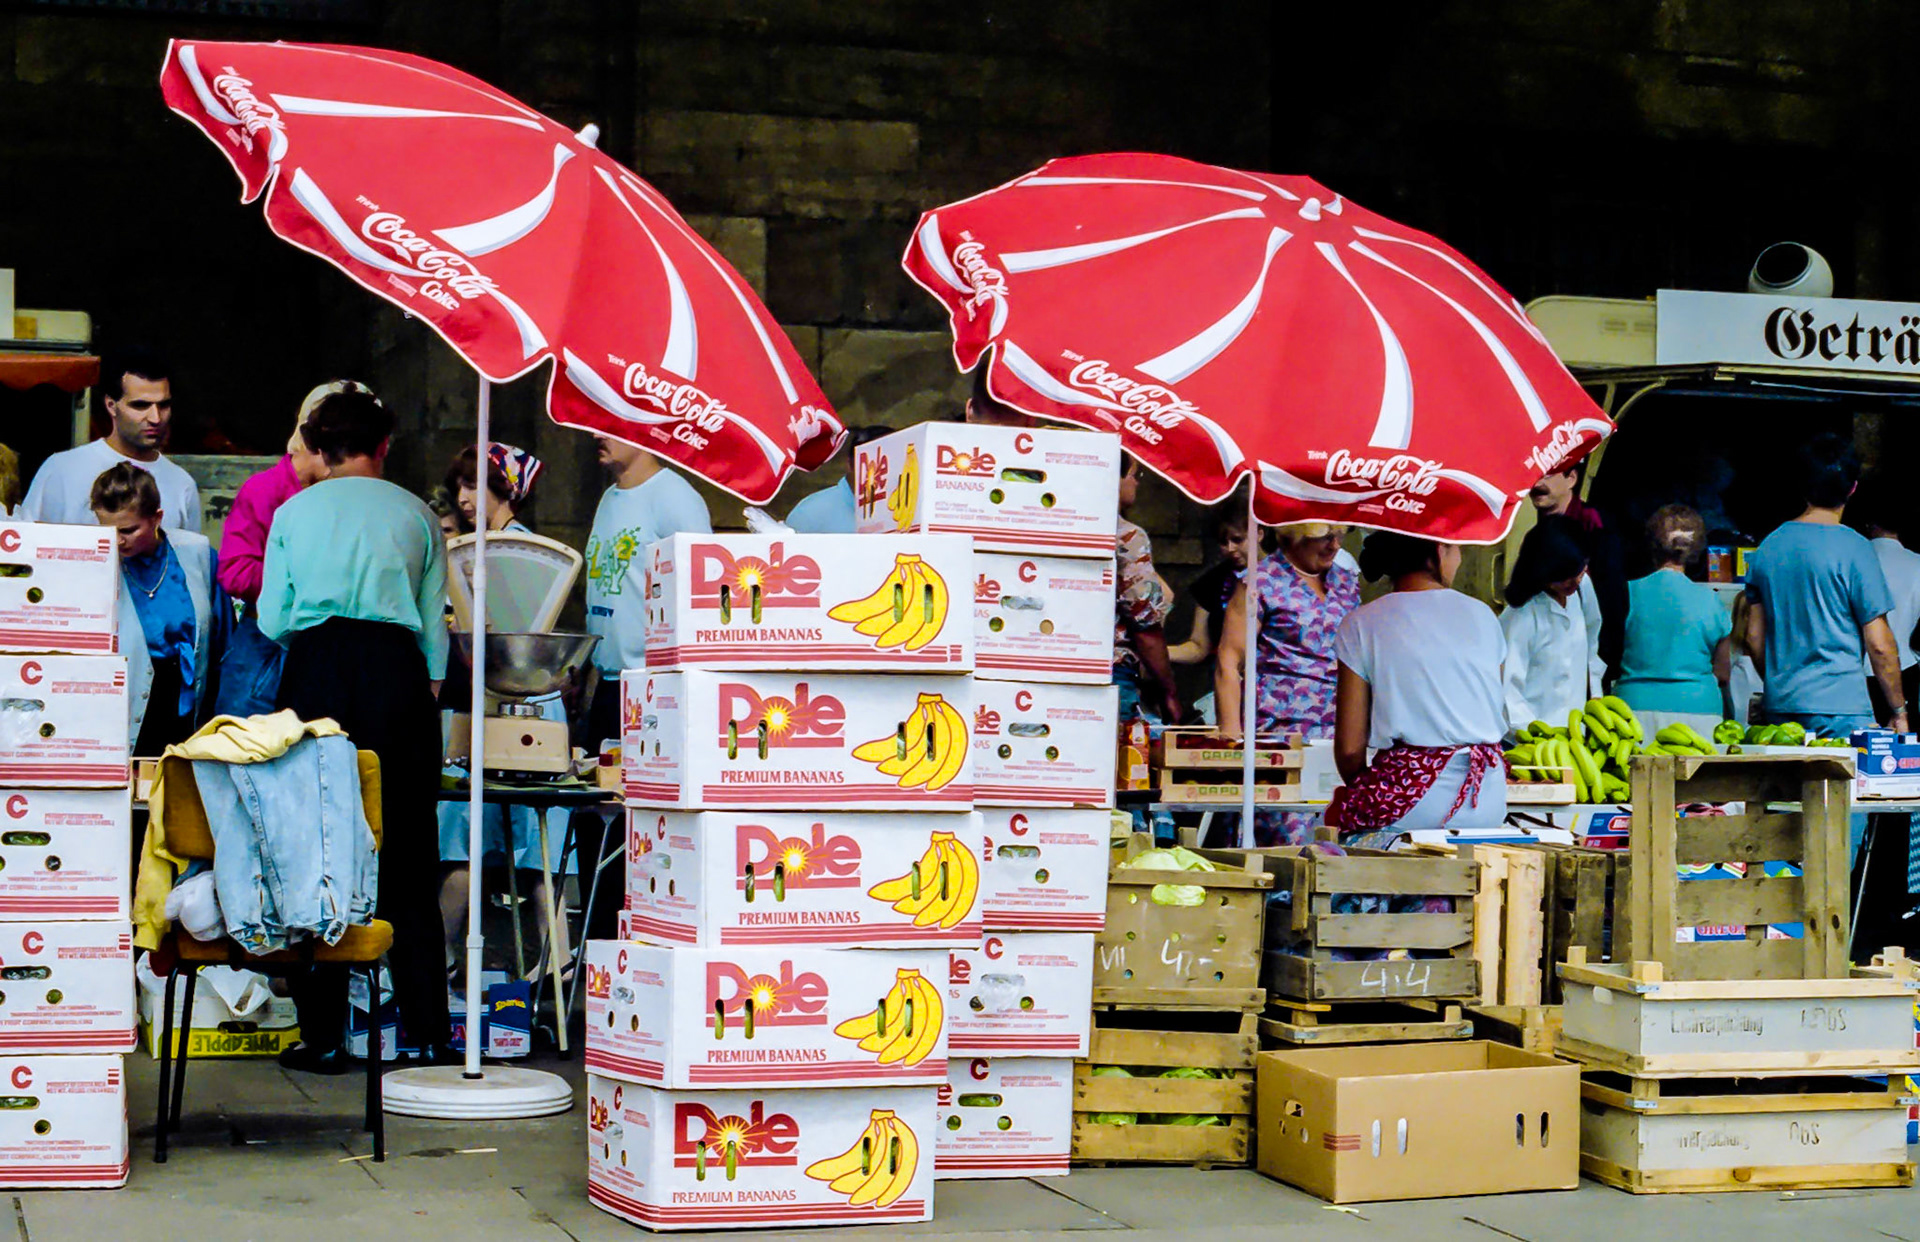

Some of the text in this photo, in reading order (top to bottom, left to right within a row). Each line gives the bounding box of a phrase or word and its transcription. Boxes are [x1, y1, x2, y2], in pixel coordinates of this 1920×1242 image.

[361, 212, 499, 299] Coca-Cola
[420, 281, 460, 310] Coke
[1764, 307, 1920, 365] Geträ
[624, 362, 727, 433] Coca-Cola
[1069, 360, 1200, 429] Coca-Cola
[672, 423, 709, 450] Coke
[1124, 415, 1163, 445] Coke
[1014, 433, 1034, 454] C
[936, 445, 996, 471] Dole
[859, 446, 888, 496] Dole
[1324, 449, 1443, 496] Coca-Cola
[935, 480, 985, 491] BANANAS
[1386, 493, 1426, 514] Coke
[0, 529, 21, 553] C
[690, 541, 822, 597] Dole
[1018, 561, 1037, 583] C
[696, 628, 823, 643] PREMIUM BANANAS
[20, 661, 43, 685] C
[718, 682, 846, 735] Dole
[1015, 690, 1033, 712] C
[721, 770, 844, 783] PREMIUM BANANAS
[6, 794, 28, 818] C
[1010, 813, 1029, 836] C
[735, 823, 862, 877] Dole
[738, 911, 861, 925] PREMIUM BANANAS
[23, 931, 44, 955] C
[984, 937, 1004, 960] C
[588, 963, 611, 993] Dole
[705, 960, 829, 1014] Dole
[193, 1033, 280, 1052] PINEAPPLE
[707, 1048, 827, 1063] PREMIUM BANANAS
[11, 1065, 33, 1089] C
[970, 1058, 990, 1081] C
[674, 1100, 800, 1155] Dole
[672, 1190, 796, 1204] PREMIUM BANANAS
